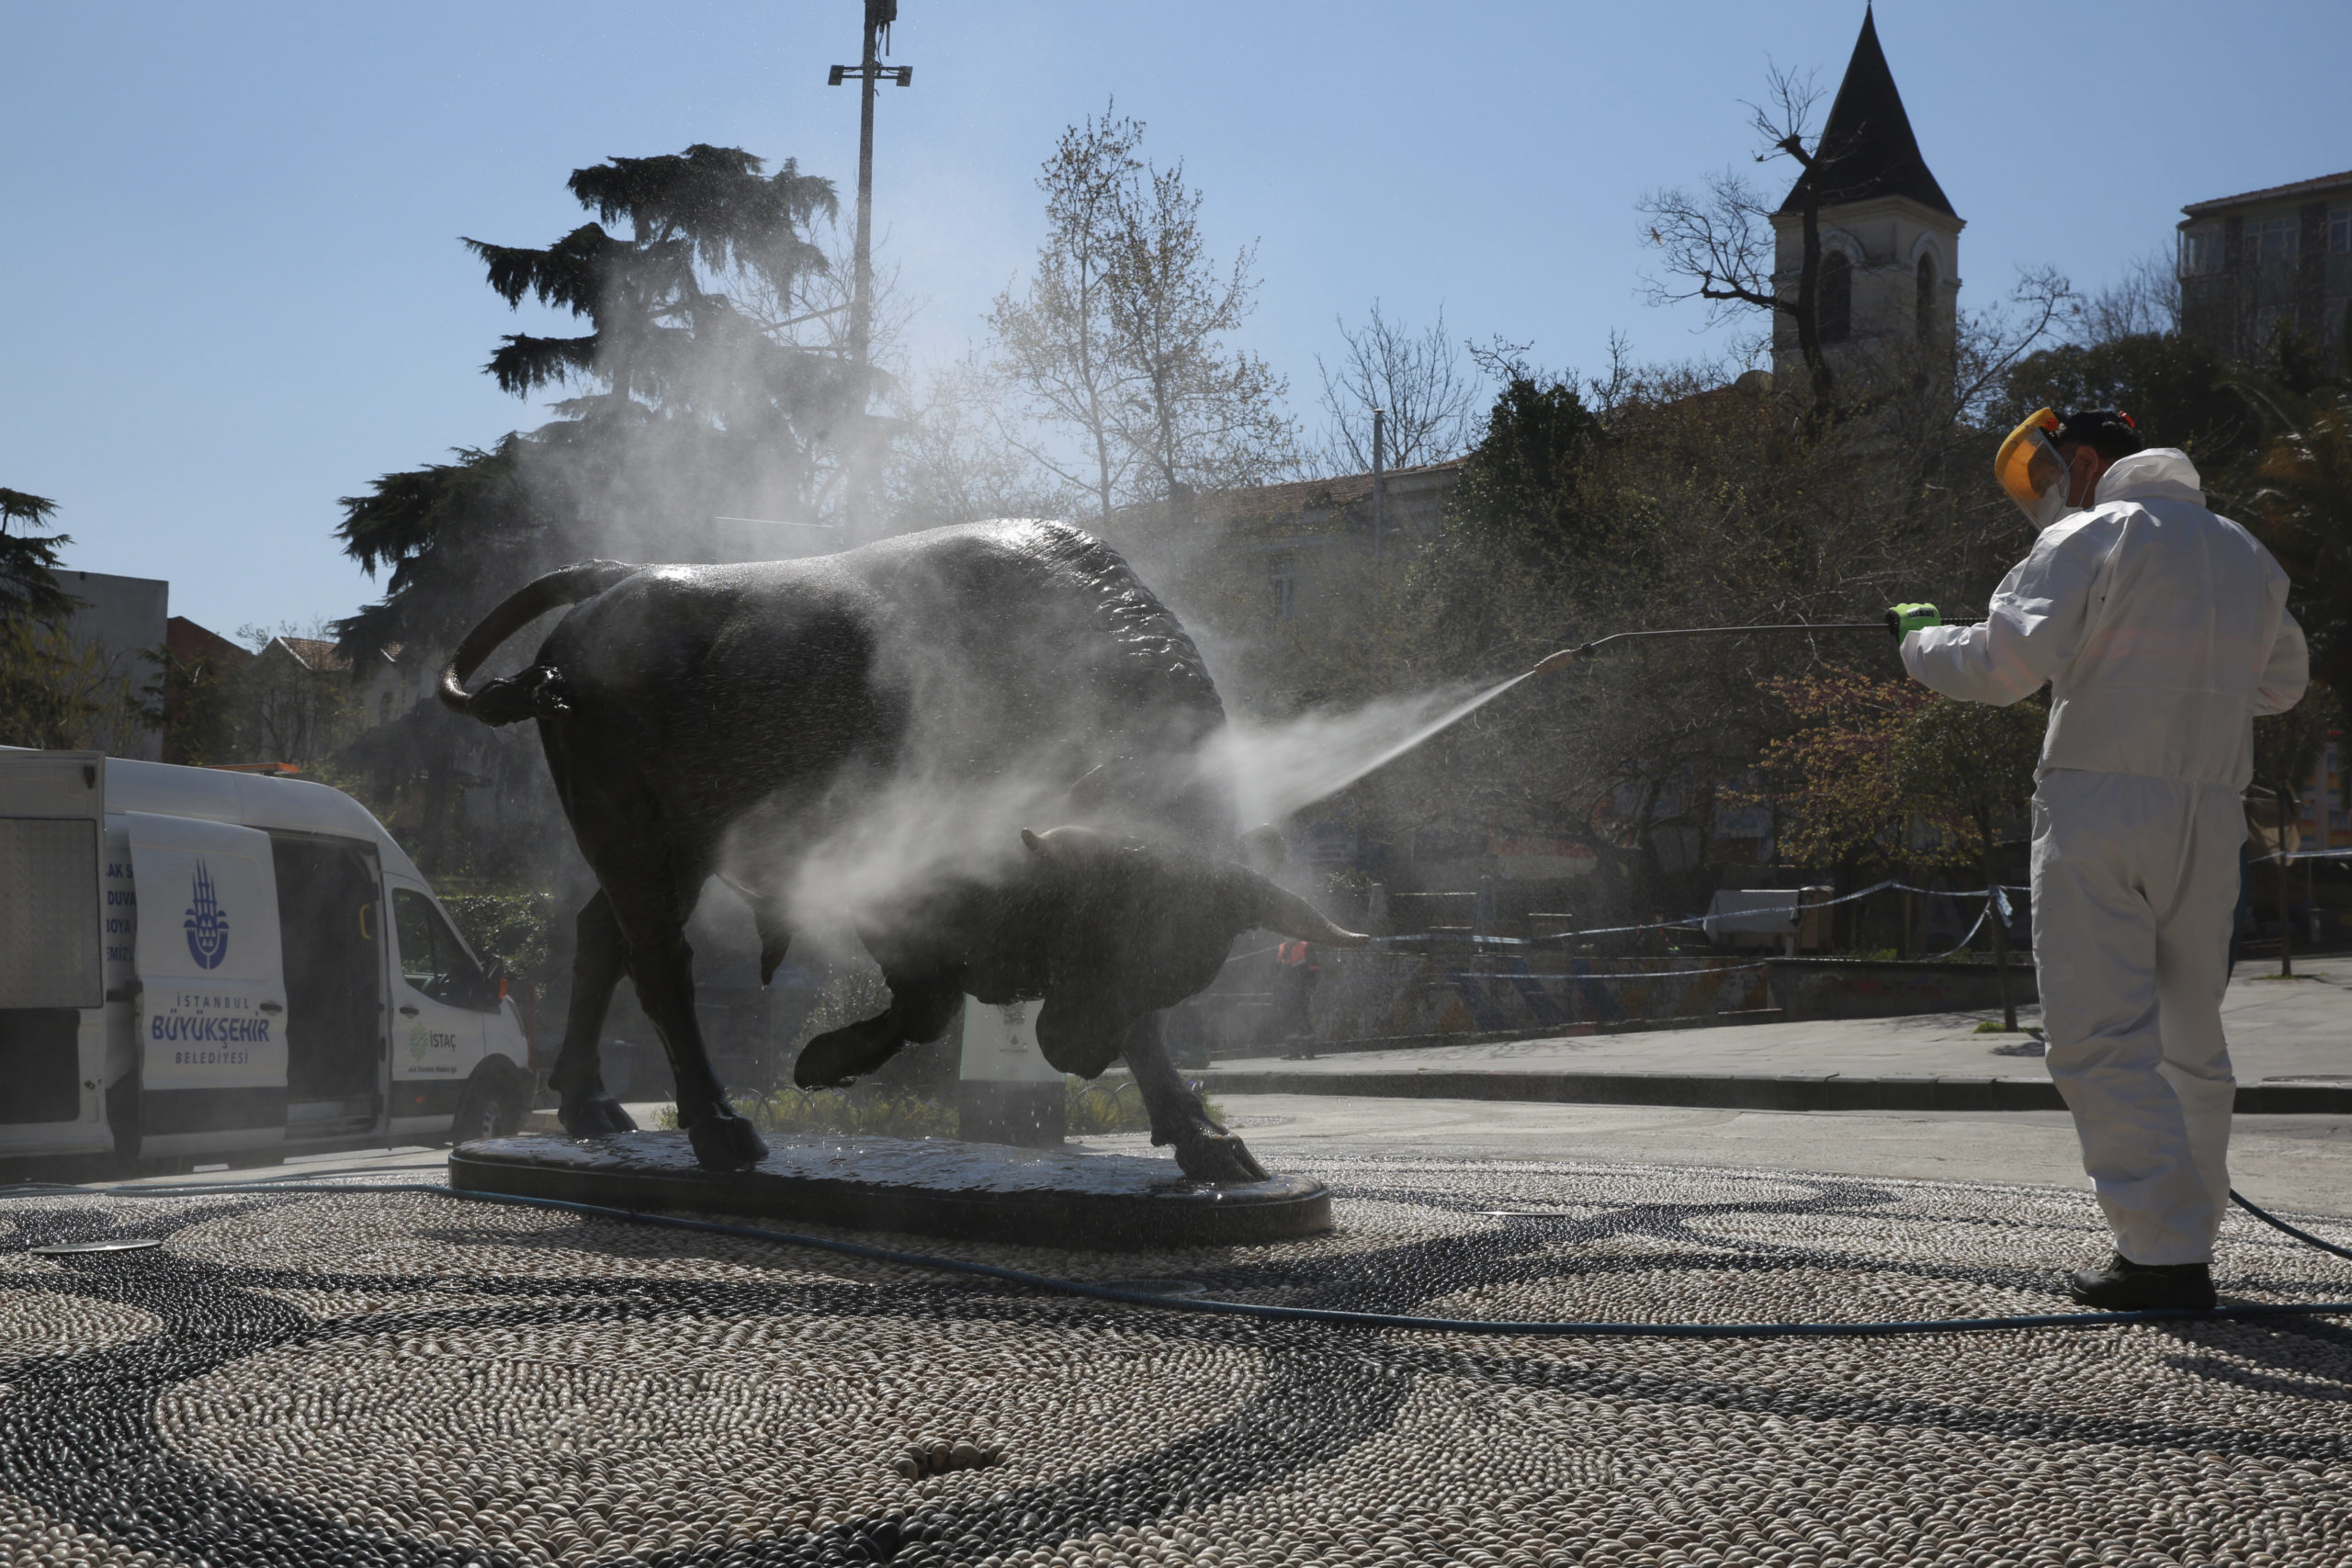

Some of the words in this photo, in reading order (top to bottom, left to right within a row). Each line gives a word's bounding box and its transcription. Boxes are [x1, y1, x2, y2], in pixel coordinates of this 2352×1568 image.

[106, 863, 123, 878] AK
[176, 992, 249, 1010] İSTANBUL
[152, 1009, 270, 1049] BÜYÜKŞEHİR
[429, 1029, 457, 1053] İSTAÇ
[175, 1049, 249, 1065] BELEDİYESİ
